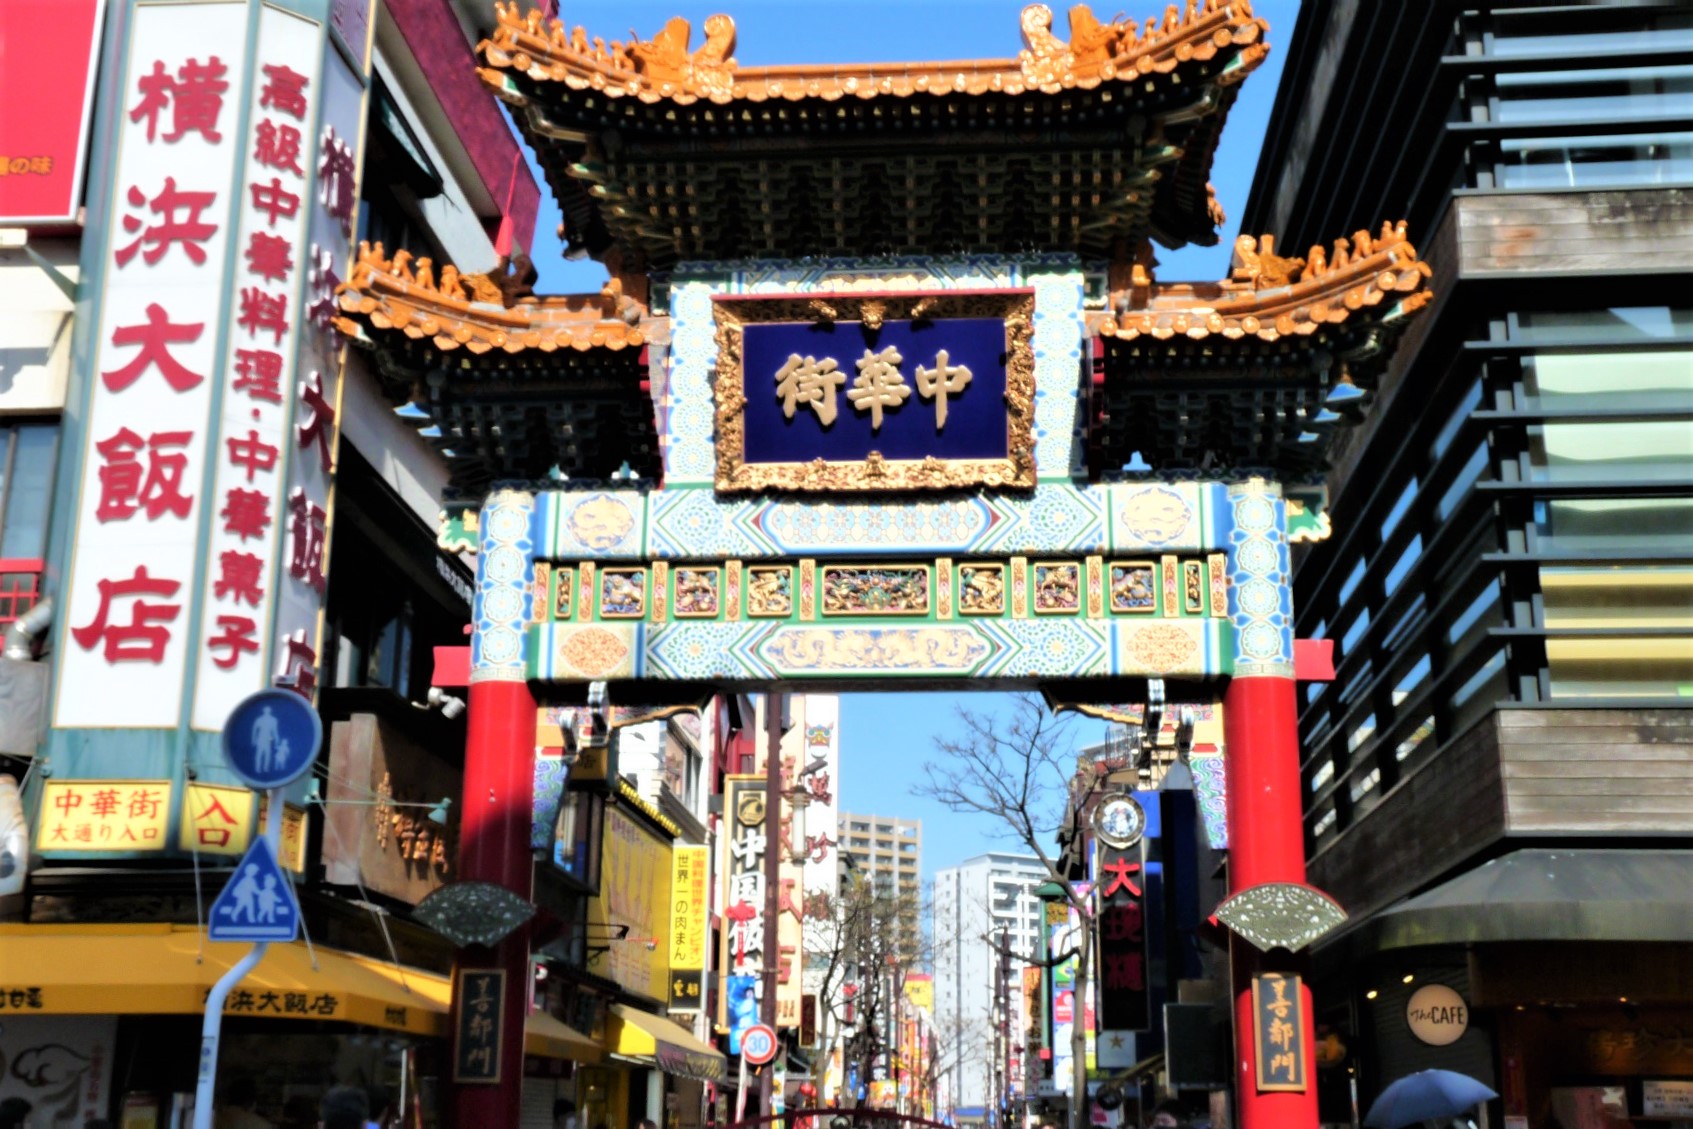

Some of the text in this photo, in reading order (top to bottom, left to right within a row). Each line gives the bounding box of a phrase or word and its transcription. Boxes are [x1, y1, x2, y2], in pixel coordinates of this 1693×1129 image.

[774, 345, 973, 430] 中華街
[55, 788, 162, 820] 中華街
[50, 823, 159, 844] 大通り入口
[195, 793, 239, 848] 入口
[673, 854, 689, 962] 世界一の肉まん
[1431, 1006, 1465, 1025] CAFE
[748, 1036, 770, 1053] 30
